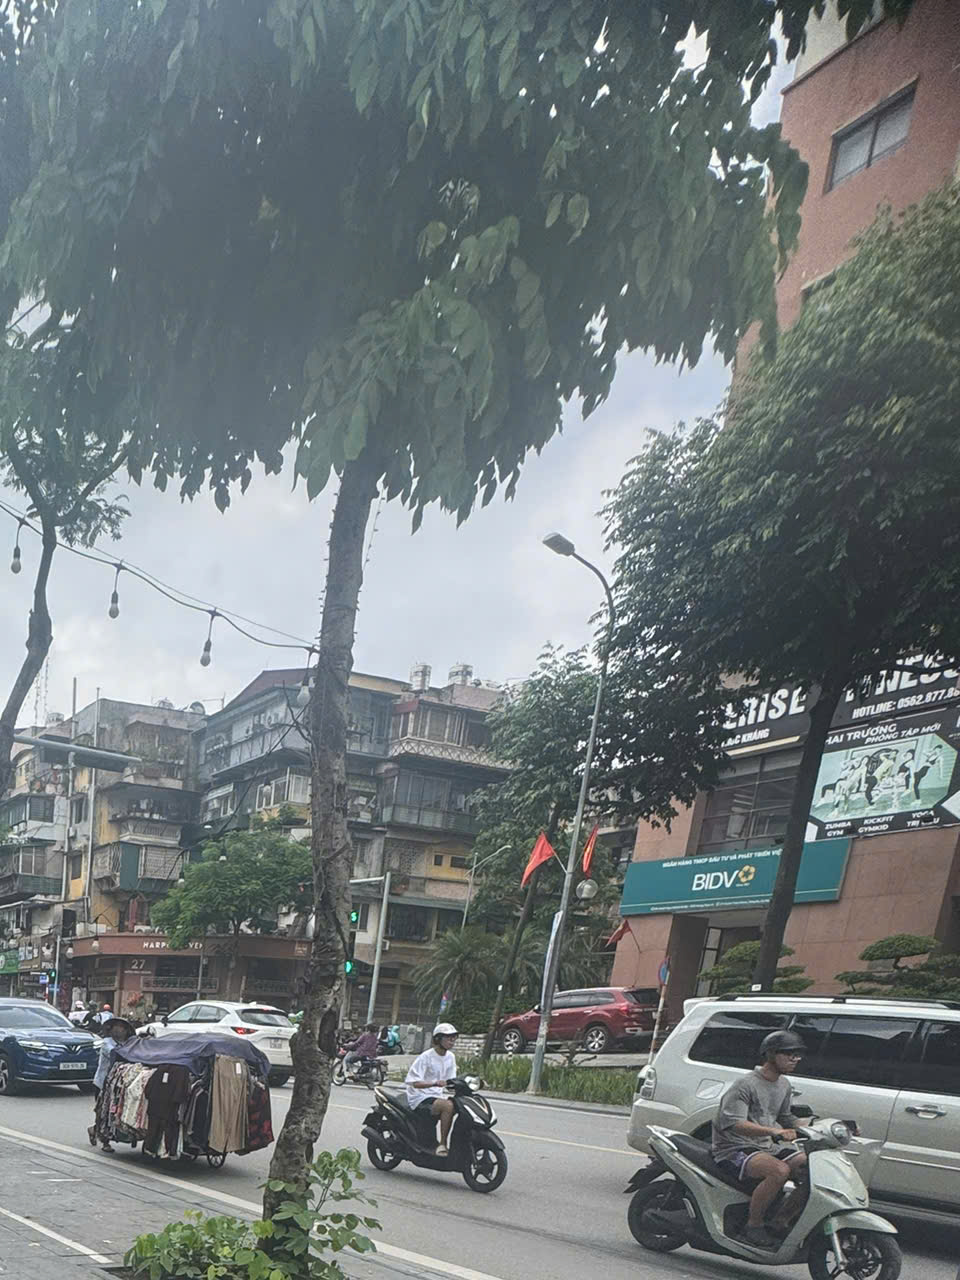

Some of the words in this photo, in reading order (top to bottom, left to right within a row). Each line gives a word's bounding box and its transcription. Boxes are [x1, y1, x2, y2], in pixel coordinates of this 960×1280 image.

[852, 701, 898, 720] HOTLINE:
[824, 821, 852, 830] ZUMBA
[692, 869, 739, 891] BIDV
[131, 958, 146, 969] 27
